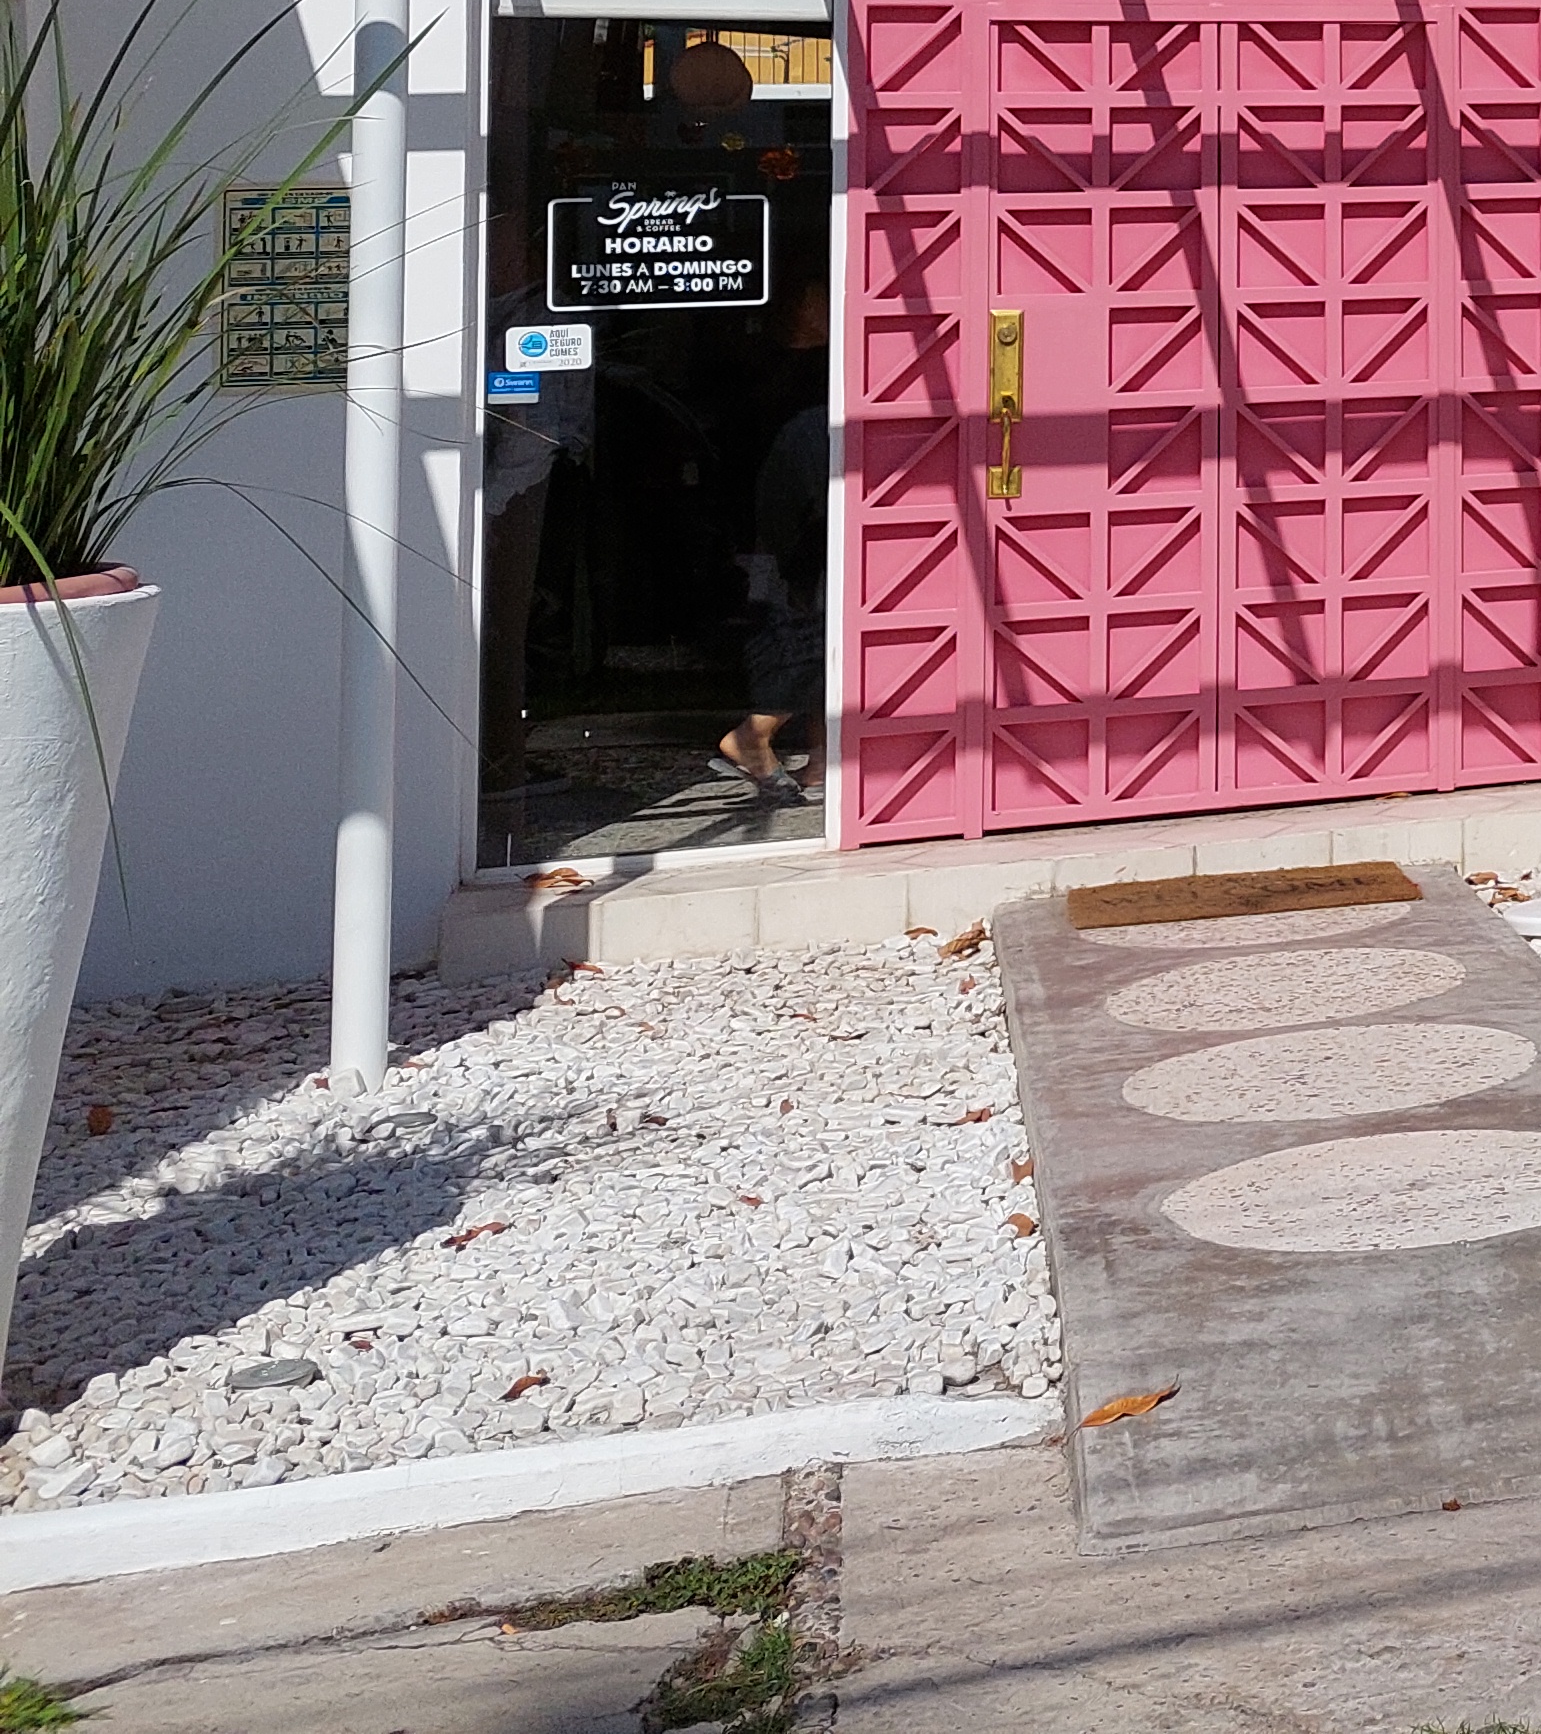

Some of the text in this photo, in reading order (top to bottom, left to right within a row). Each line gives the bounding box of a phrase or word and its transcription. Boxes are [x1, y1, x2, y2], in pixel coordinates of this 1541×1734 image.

[612, 182, 637, 191] PAN
[597, 187, 722, 233] Springs
[645, 224, 682, 232] COFFEE
[605, 235, 713, 254] HORARIO
[571, 259, 753, 278] LUNES A DOMINGO
[580, 280, 622, 294] 7:30
[625, 278, 654, 293] AM
[673, 277, 714, 292] 3:00
[718, 276, 744, 291] PM
[549, 338, 582, 347] SEGURO
[549, 347, 578, 357] COMES
[558, 358, 582, 366] 2020
